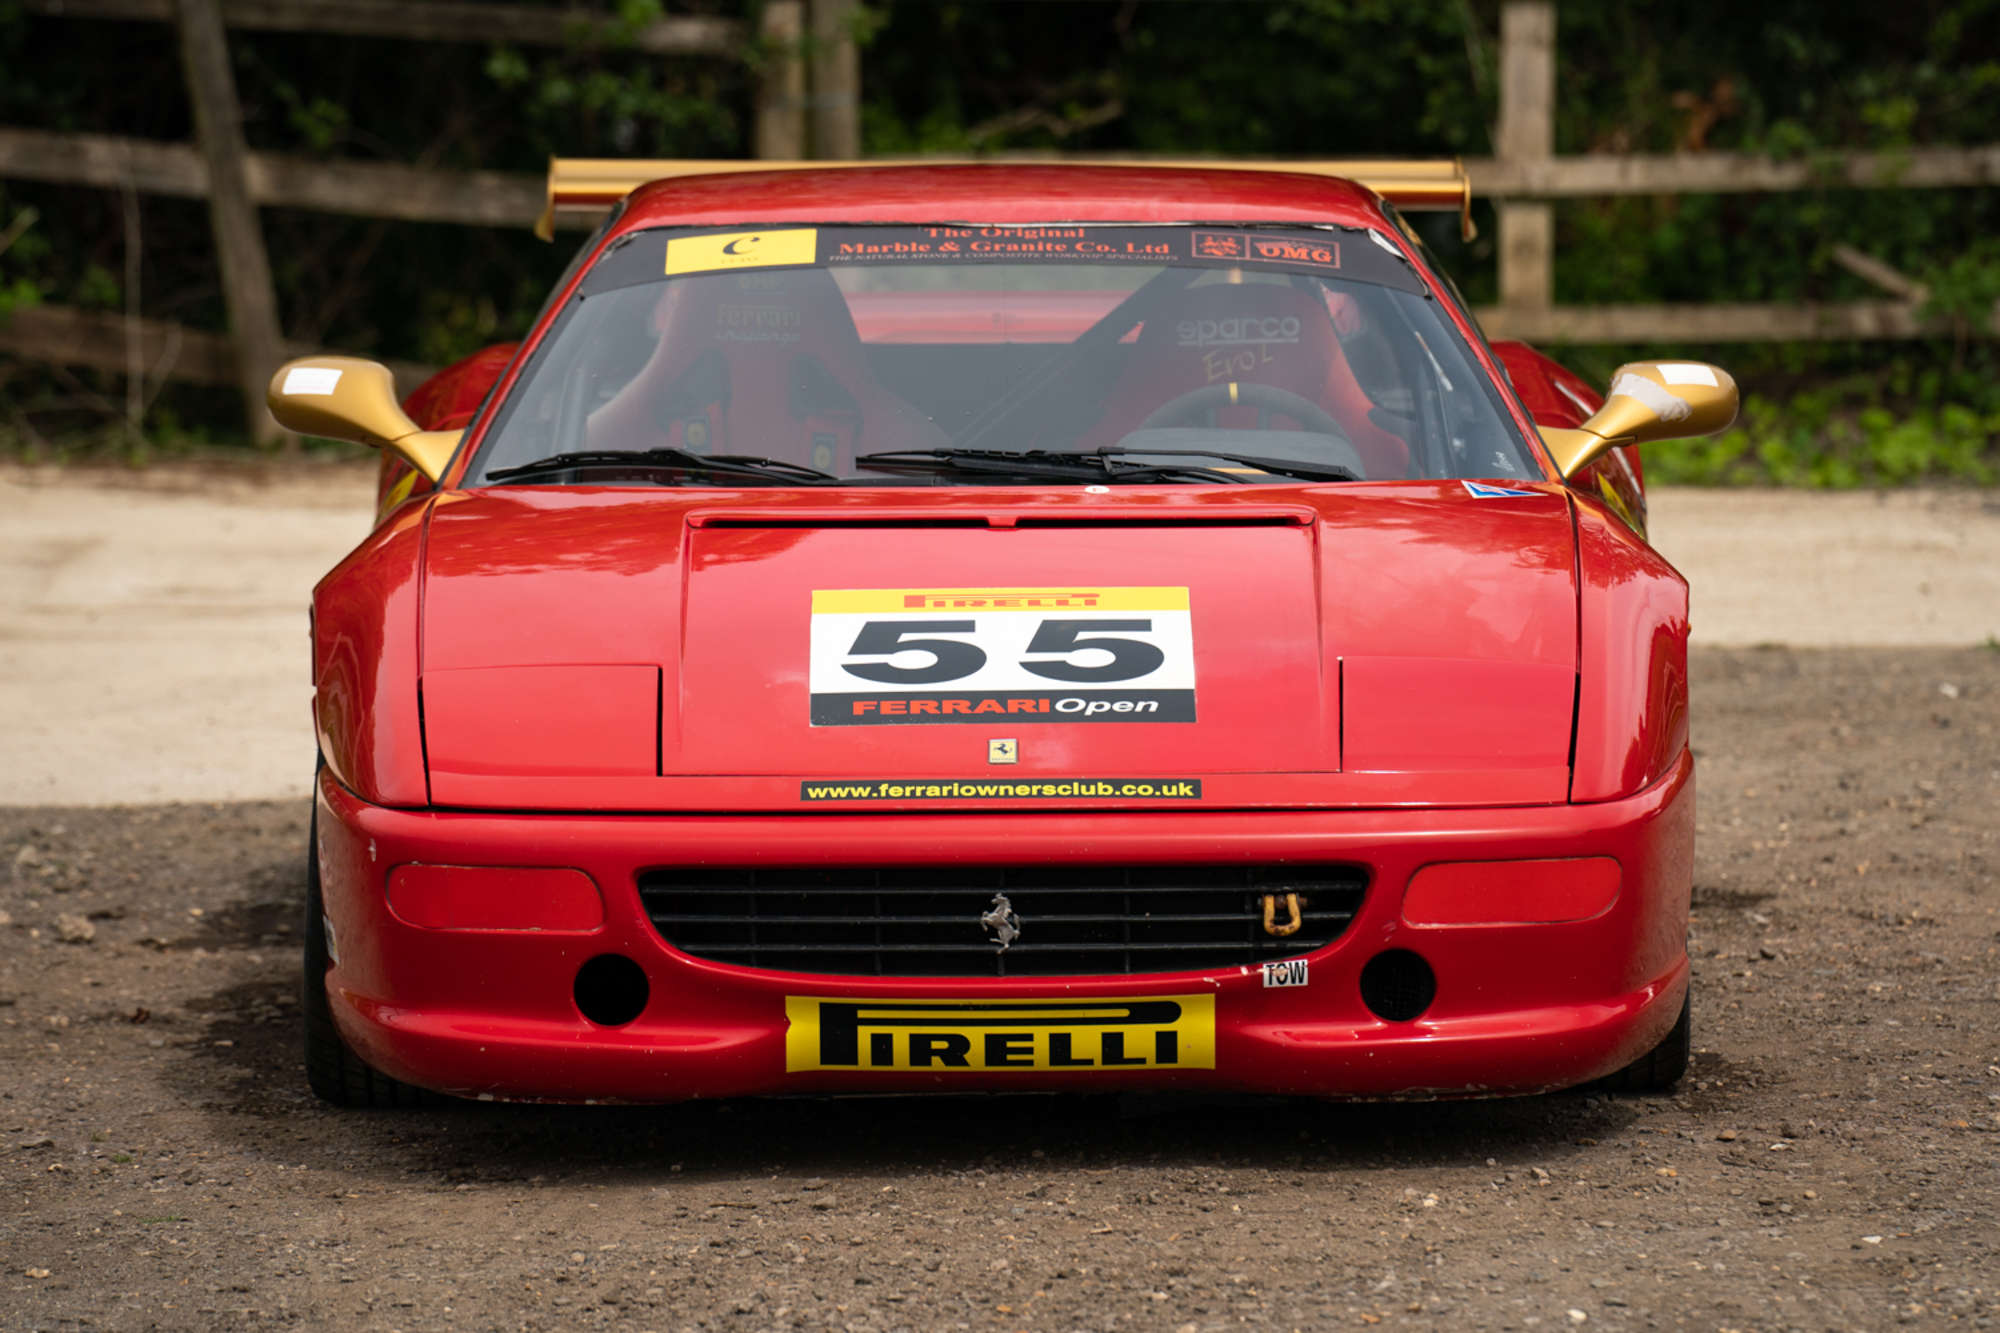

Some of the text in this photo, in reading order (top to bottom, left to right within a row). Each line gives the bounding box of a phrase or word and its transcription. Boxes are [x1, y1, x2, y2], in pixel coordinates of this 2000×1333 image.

[923, 227, 1086, 239] The Original
[839, 240, 1170, 254] Marble & Granite Co. Ltd
[1176, 316, 1301, 346] sparco
[903, 592, 1101, 608] PIRELLI
[840, 618, 1165, 685] 55
[852, 697, 1160, 716] FERRARI Open
[806, 781, 1194, 799] www.ferrariownersclub.co.uk
[1265, 961, 1306, 986] TOW
[818, 1000, 1183, 1067] PIRELLI
